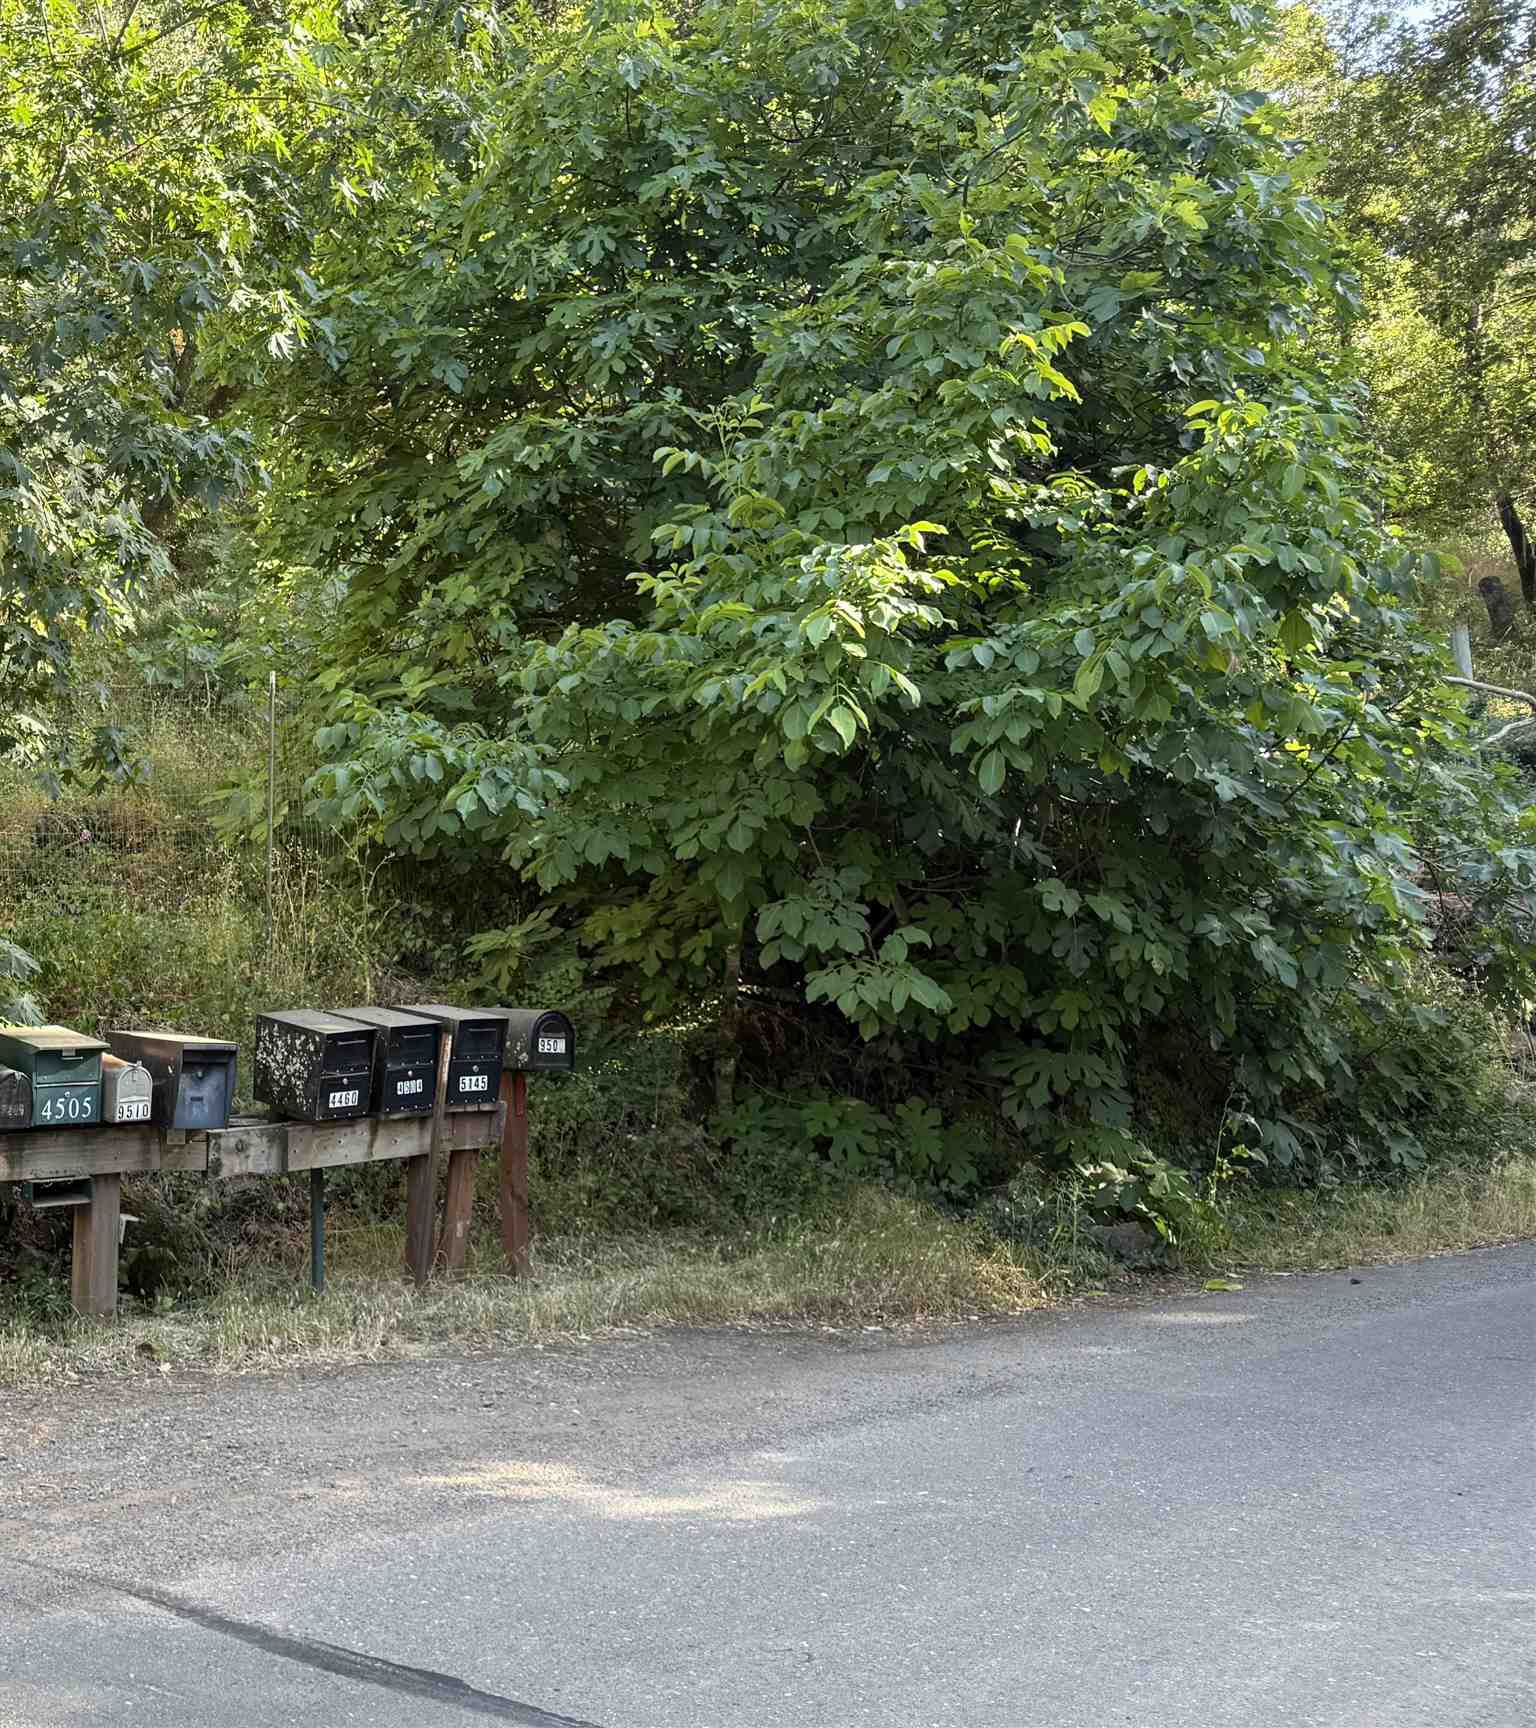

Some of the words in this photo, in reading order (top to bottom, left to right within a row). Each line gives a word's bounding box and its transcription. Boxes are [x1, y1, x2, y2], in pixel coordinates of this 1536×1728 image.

[460, 1076, 487, 1091] 5145
[330, 1091, 358, 1106] 4460
[41, 1097, 92, 1120] 4505
[117, 1103, 149, 1120] 9510
